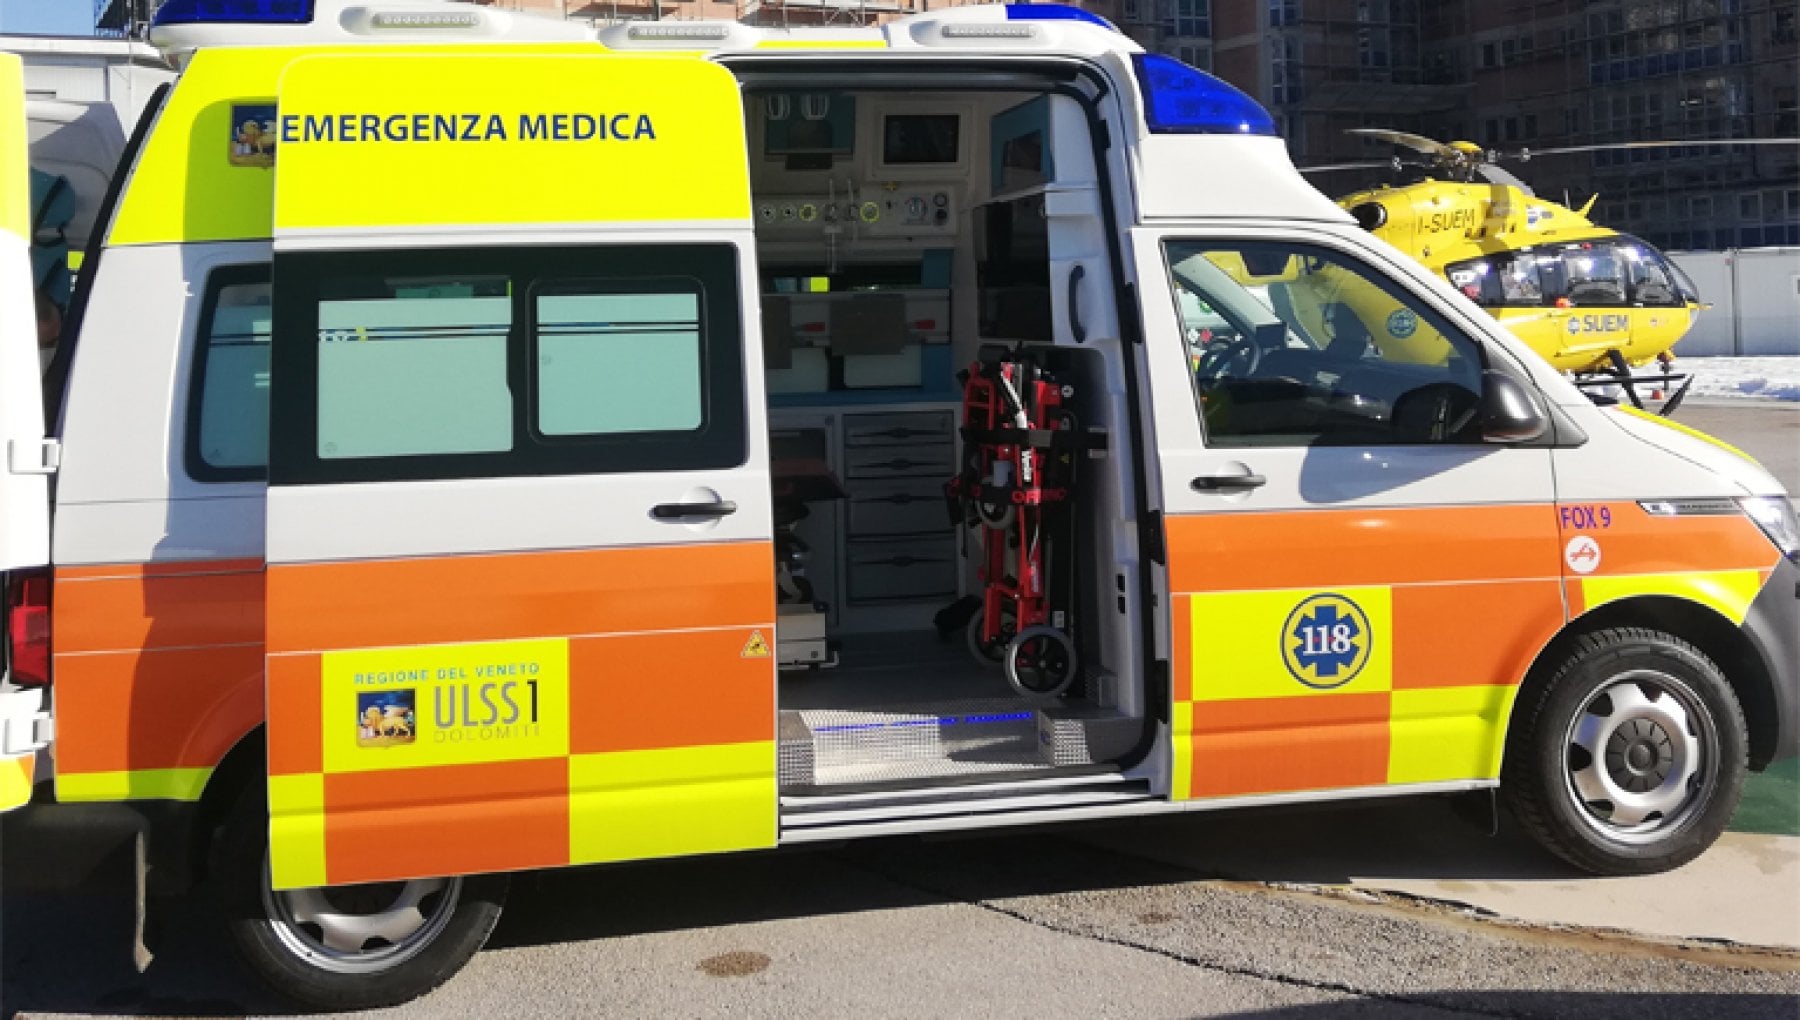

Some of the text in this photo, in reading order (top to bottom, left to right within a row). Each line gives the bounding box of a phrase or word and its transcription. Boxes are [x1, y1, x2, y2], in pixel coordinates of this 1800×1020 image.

[281, 113, 656, 142] EMERGENZA MEDICA
[1417, 208, 1475, 235] I-SUEM
[1583, 314, 1629, 332] SUEM
[1560, 506, 1612, 529] FOX 9
[1302, 622, 1351, 656] 118
[354, 662, 541, 685] REGIONE DEL VENETO
[433, 724, 540, 744] DOLOMITI
